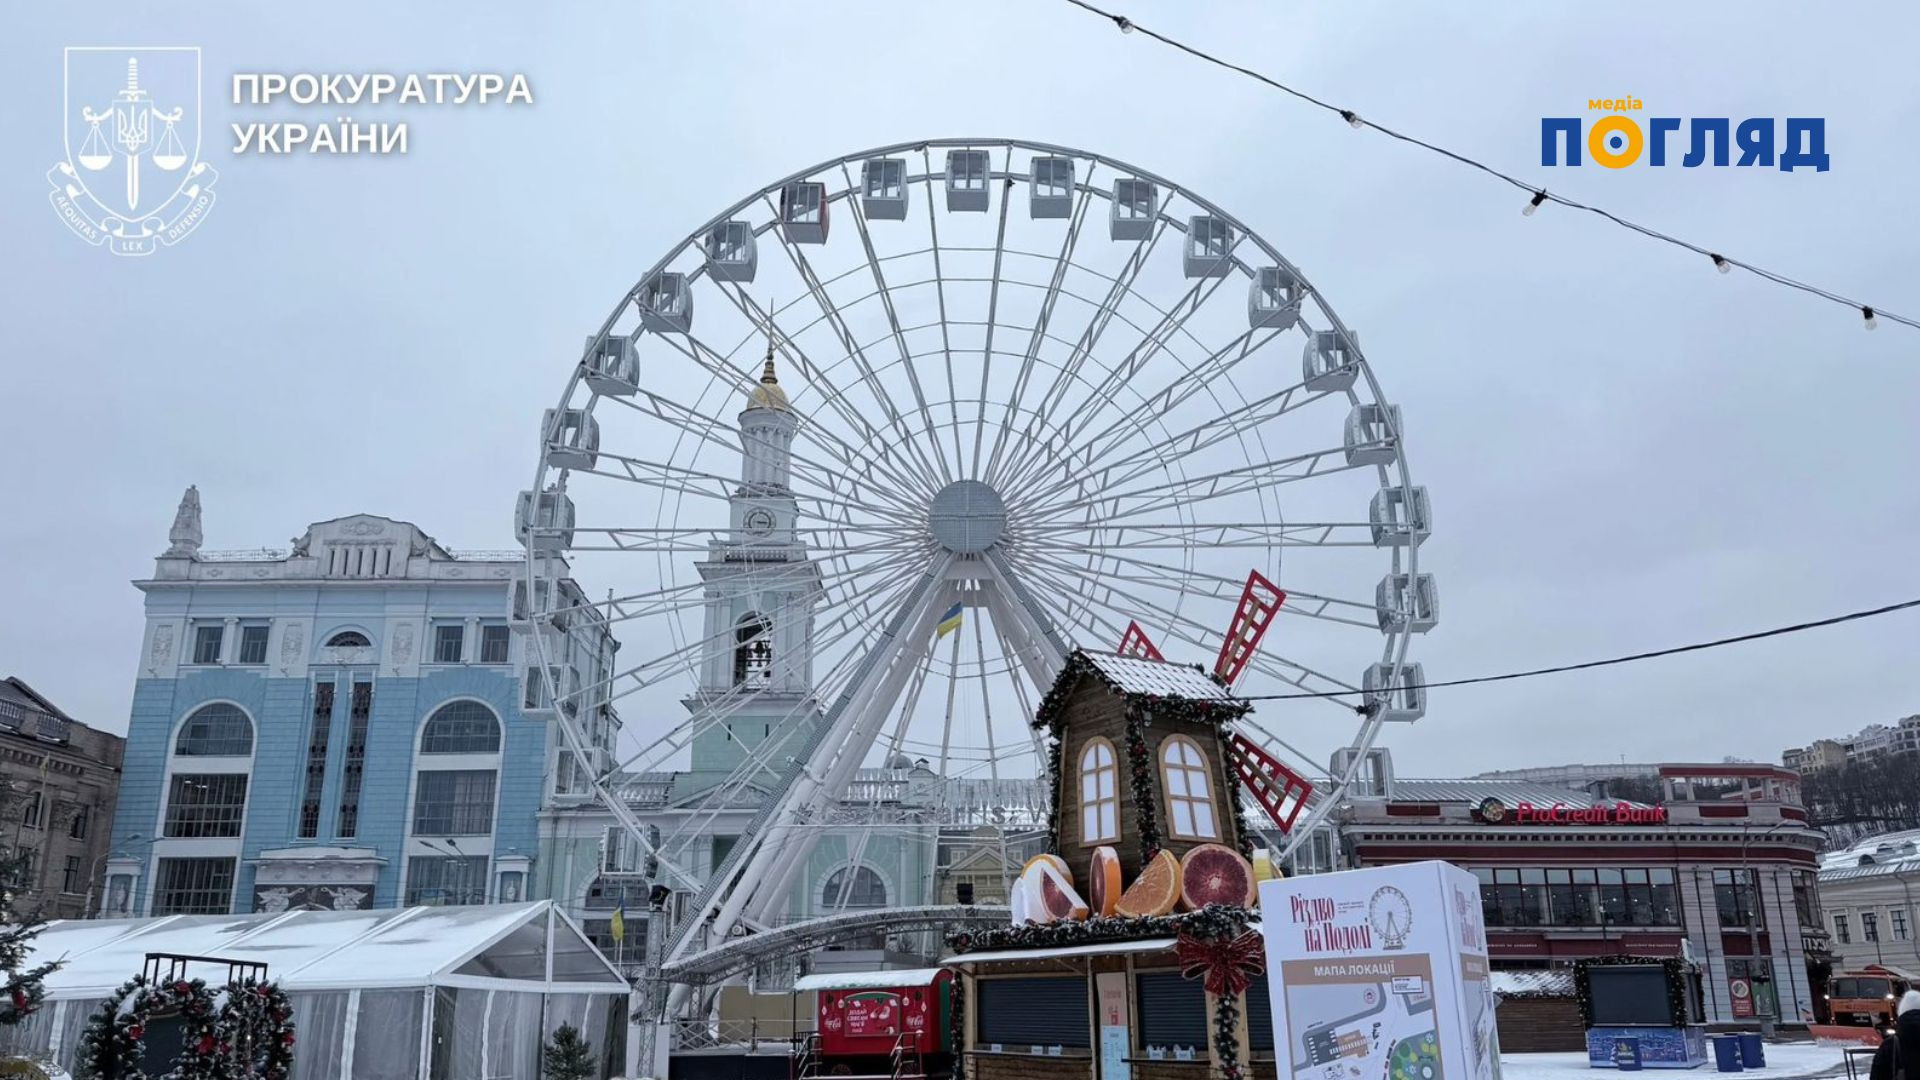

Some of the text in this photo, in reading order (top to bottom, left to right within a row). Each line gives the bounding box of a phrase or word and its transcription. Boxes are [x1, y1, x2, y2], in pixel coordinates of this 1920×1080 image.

[1517, 800, 1666, 823] ProCredit Bank
[1290, 893, 1335, 927] Різдво
[1304, 917, 1372, 954] на Подолі
[1314, 960, 1395, 976] МАПА ЛОКАЦІЇ
